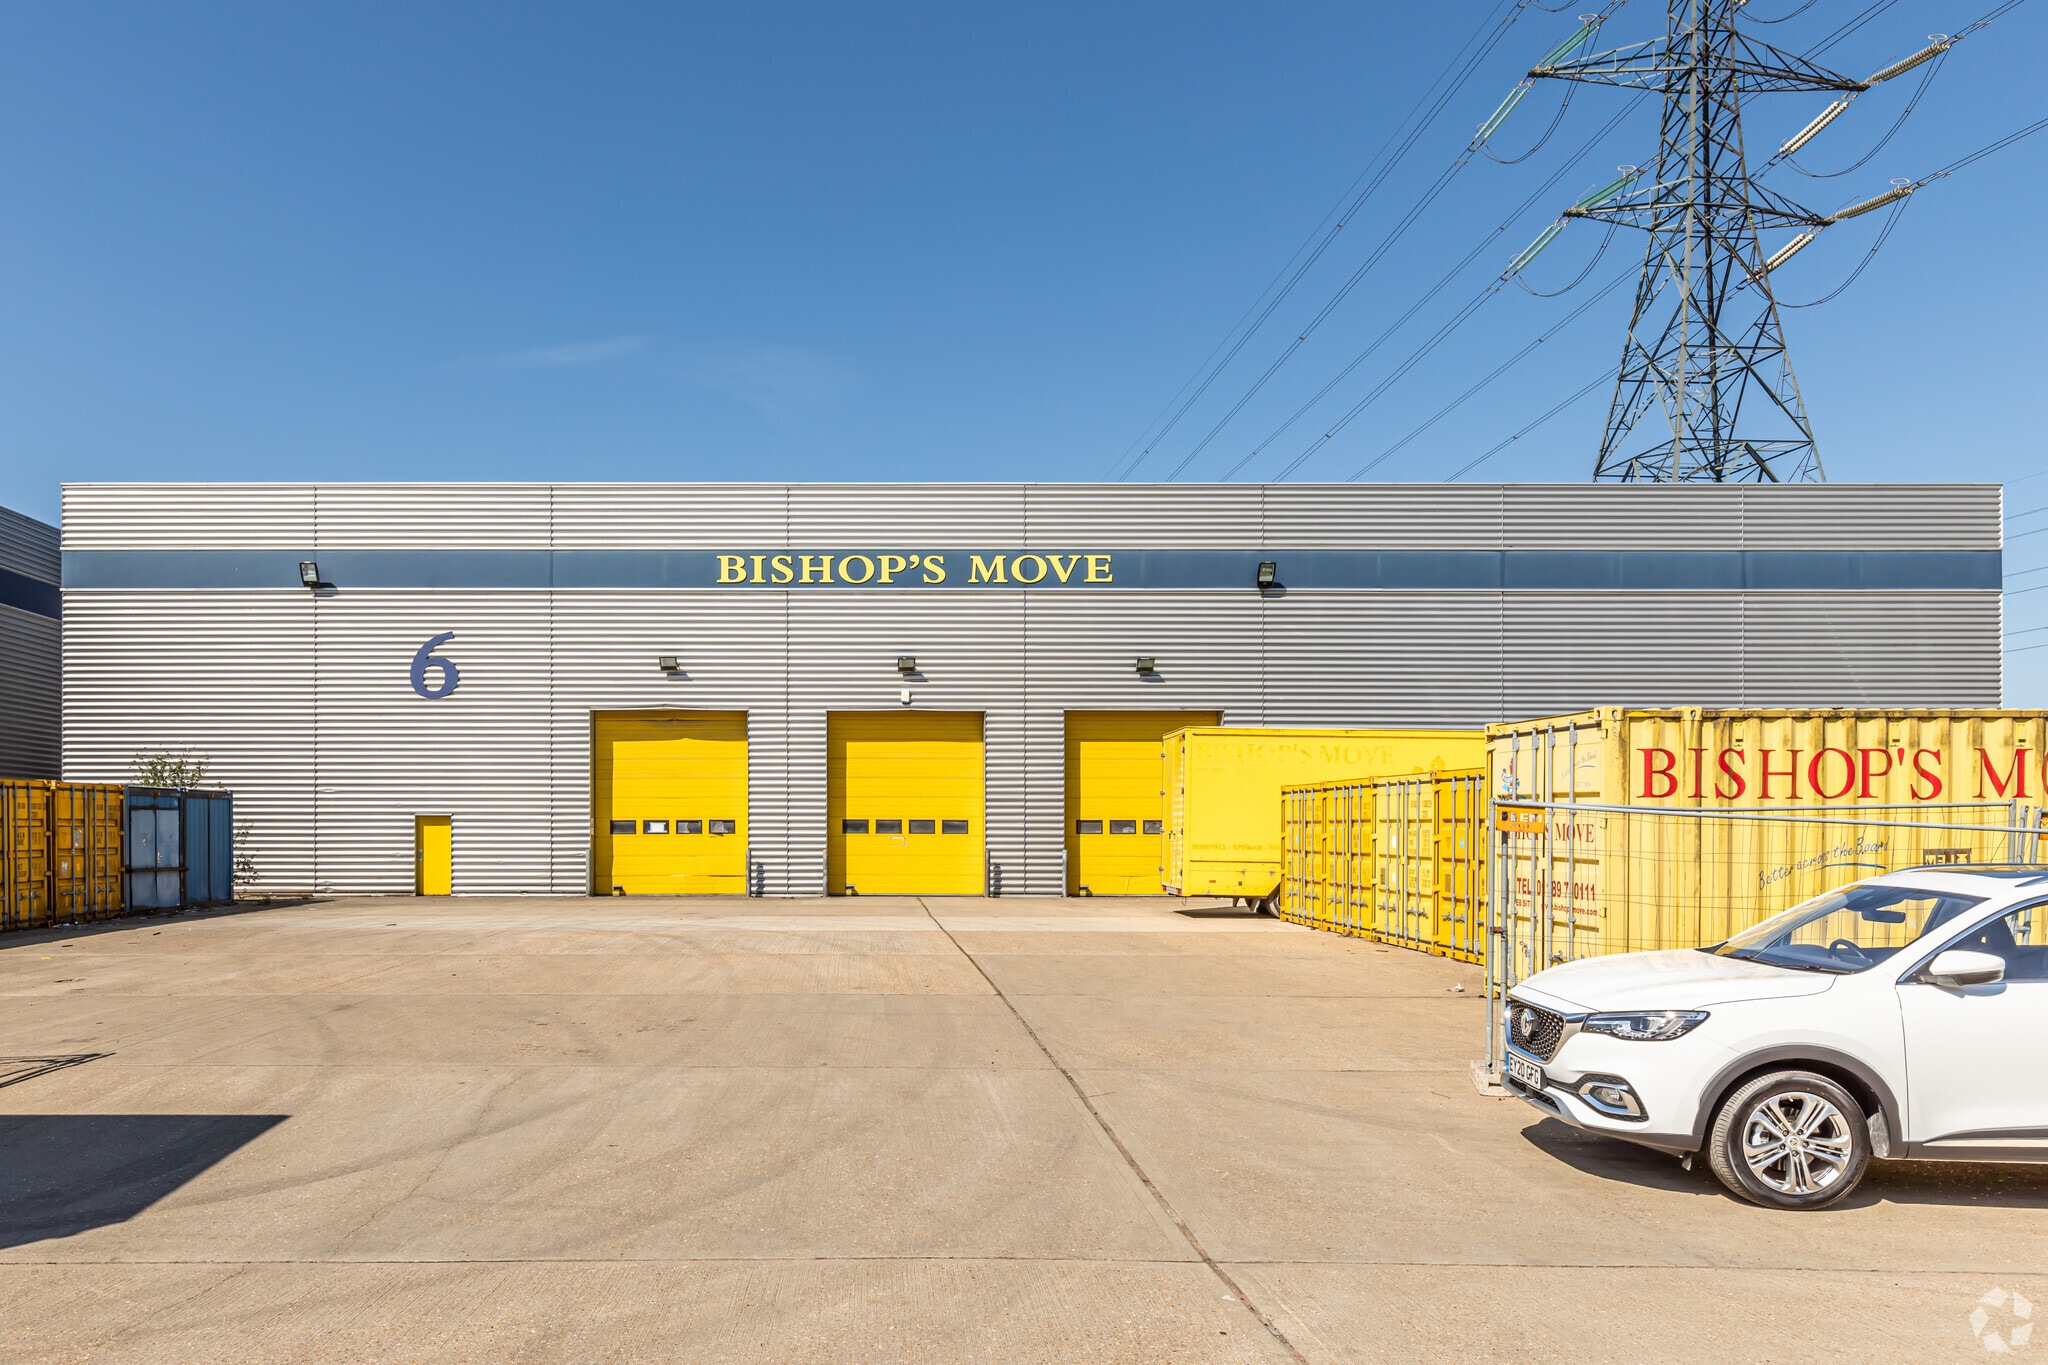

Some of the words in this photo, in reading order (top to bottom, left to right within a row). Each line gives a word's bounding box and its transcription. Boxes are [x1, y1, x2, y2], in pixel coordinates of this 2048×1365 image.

[716, 554, 947, 585] BISHOP'S
[967, 554, 1114, 584] MOVE
[409, 631, 460, 699] 6
[1319, 744, 1394, 765] MOVE
[1636, 747, 1943, 801] BISHOP'S
[1972, 747, 2048, 799] M
[1758, 865, 1794, 891] Better
[1833, 841, 1855, 858] the
[1856, 836, 1890, 855] Board
[1517, 877, 1531, 895] TEL
